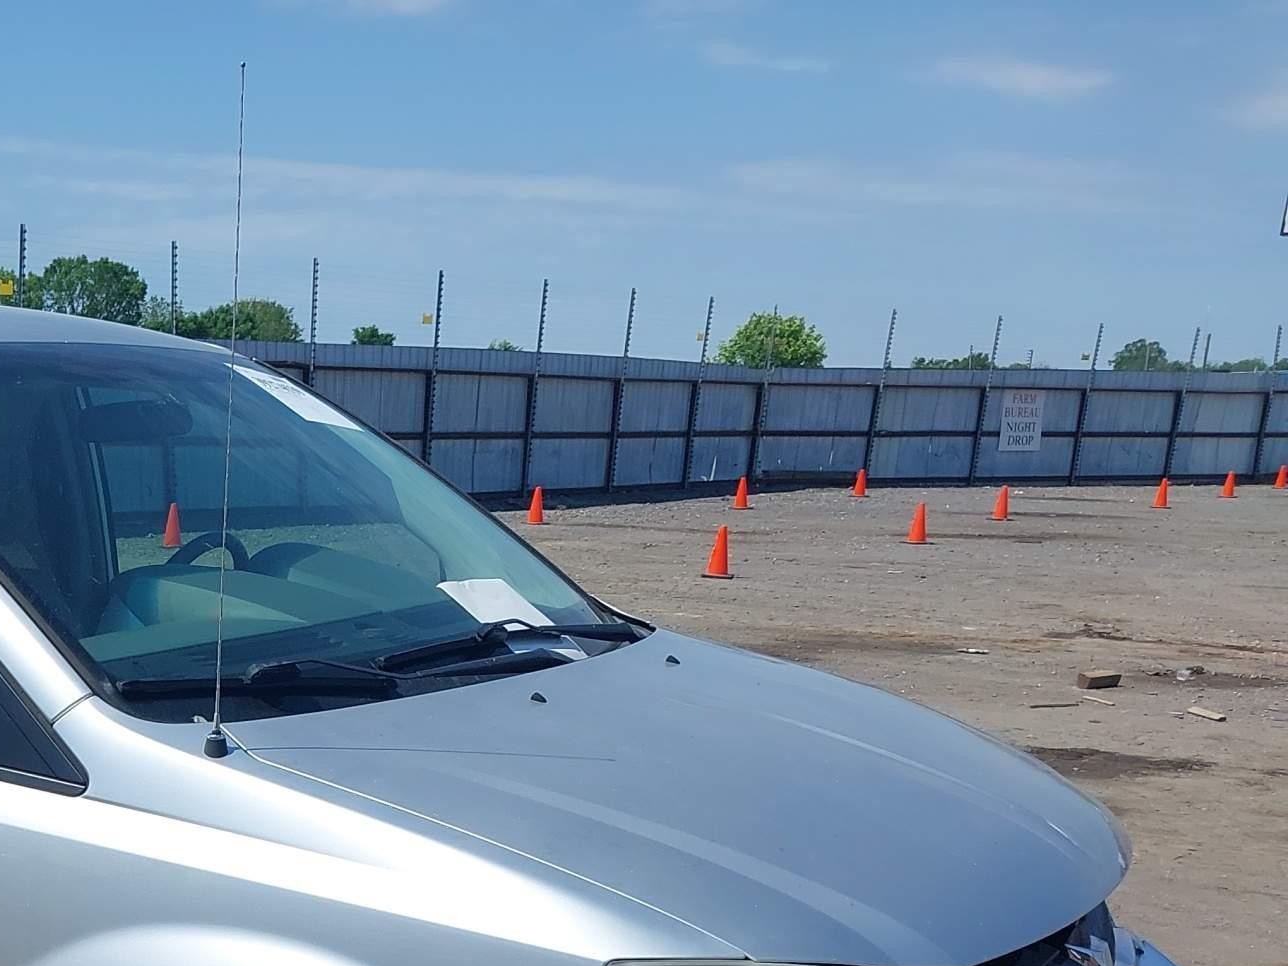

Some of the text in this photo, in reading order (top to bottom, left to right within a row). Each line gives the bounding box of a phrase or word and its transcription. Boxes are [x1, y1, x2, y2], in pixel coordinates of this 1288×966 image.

[1012, 393, 1037, 404] FARM
[1005, 407, 1041, 418] BUREAU
[1007, 422, 1037, 432] NIGHT
[1007, 436, 1034, 446] DROP
